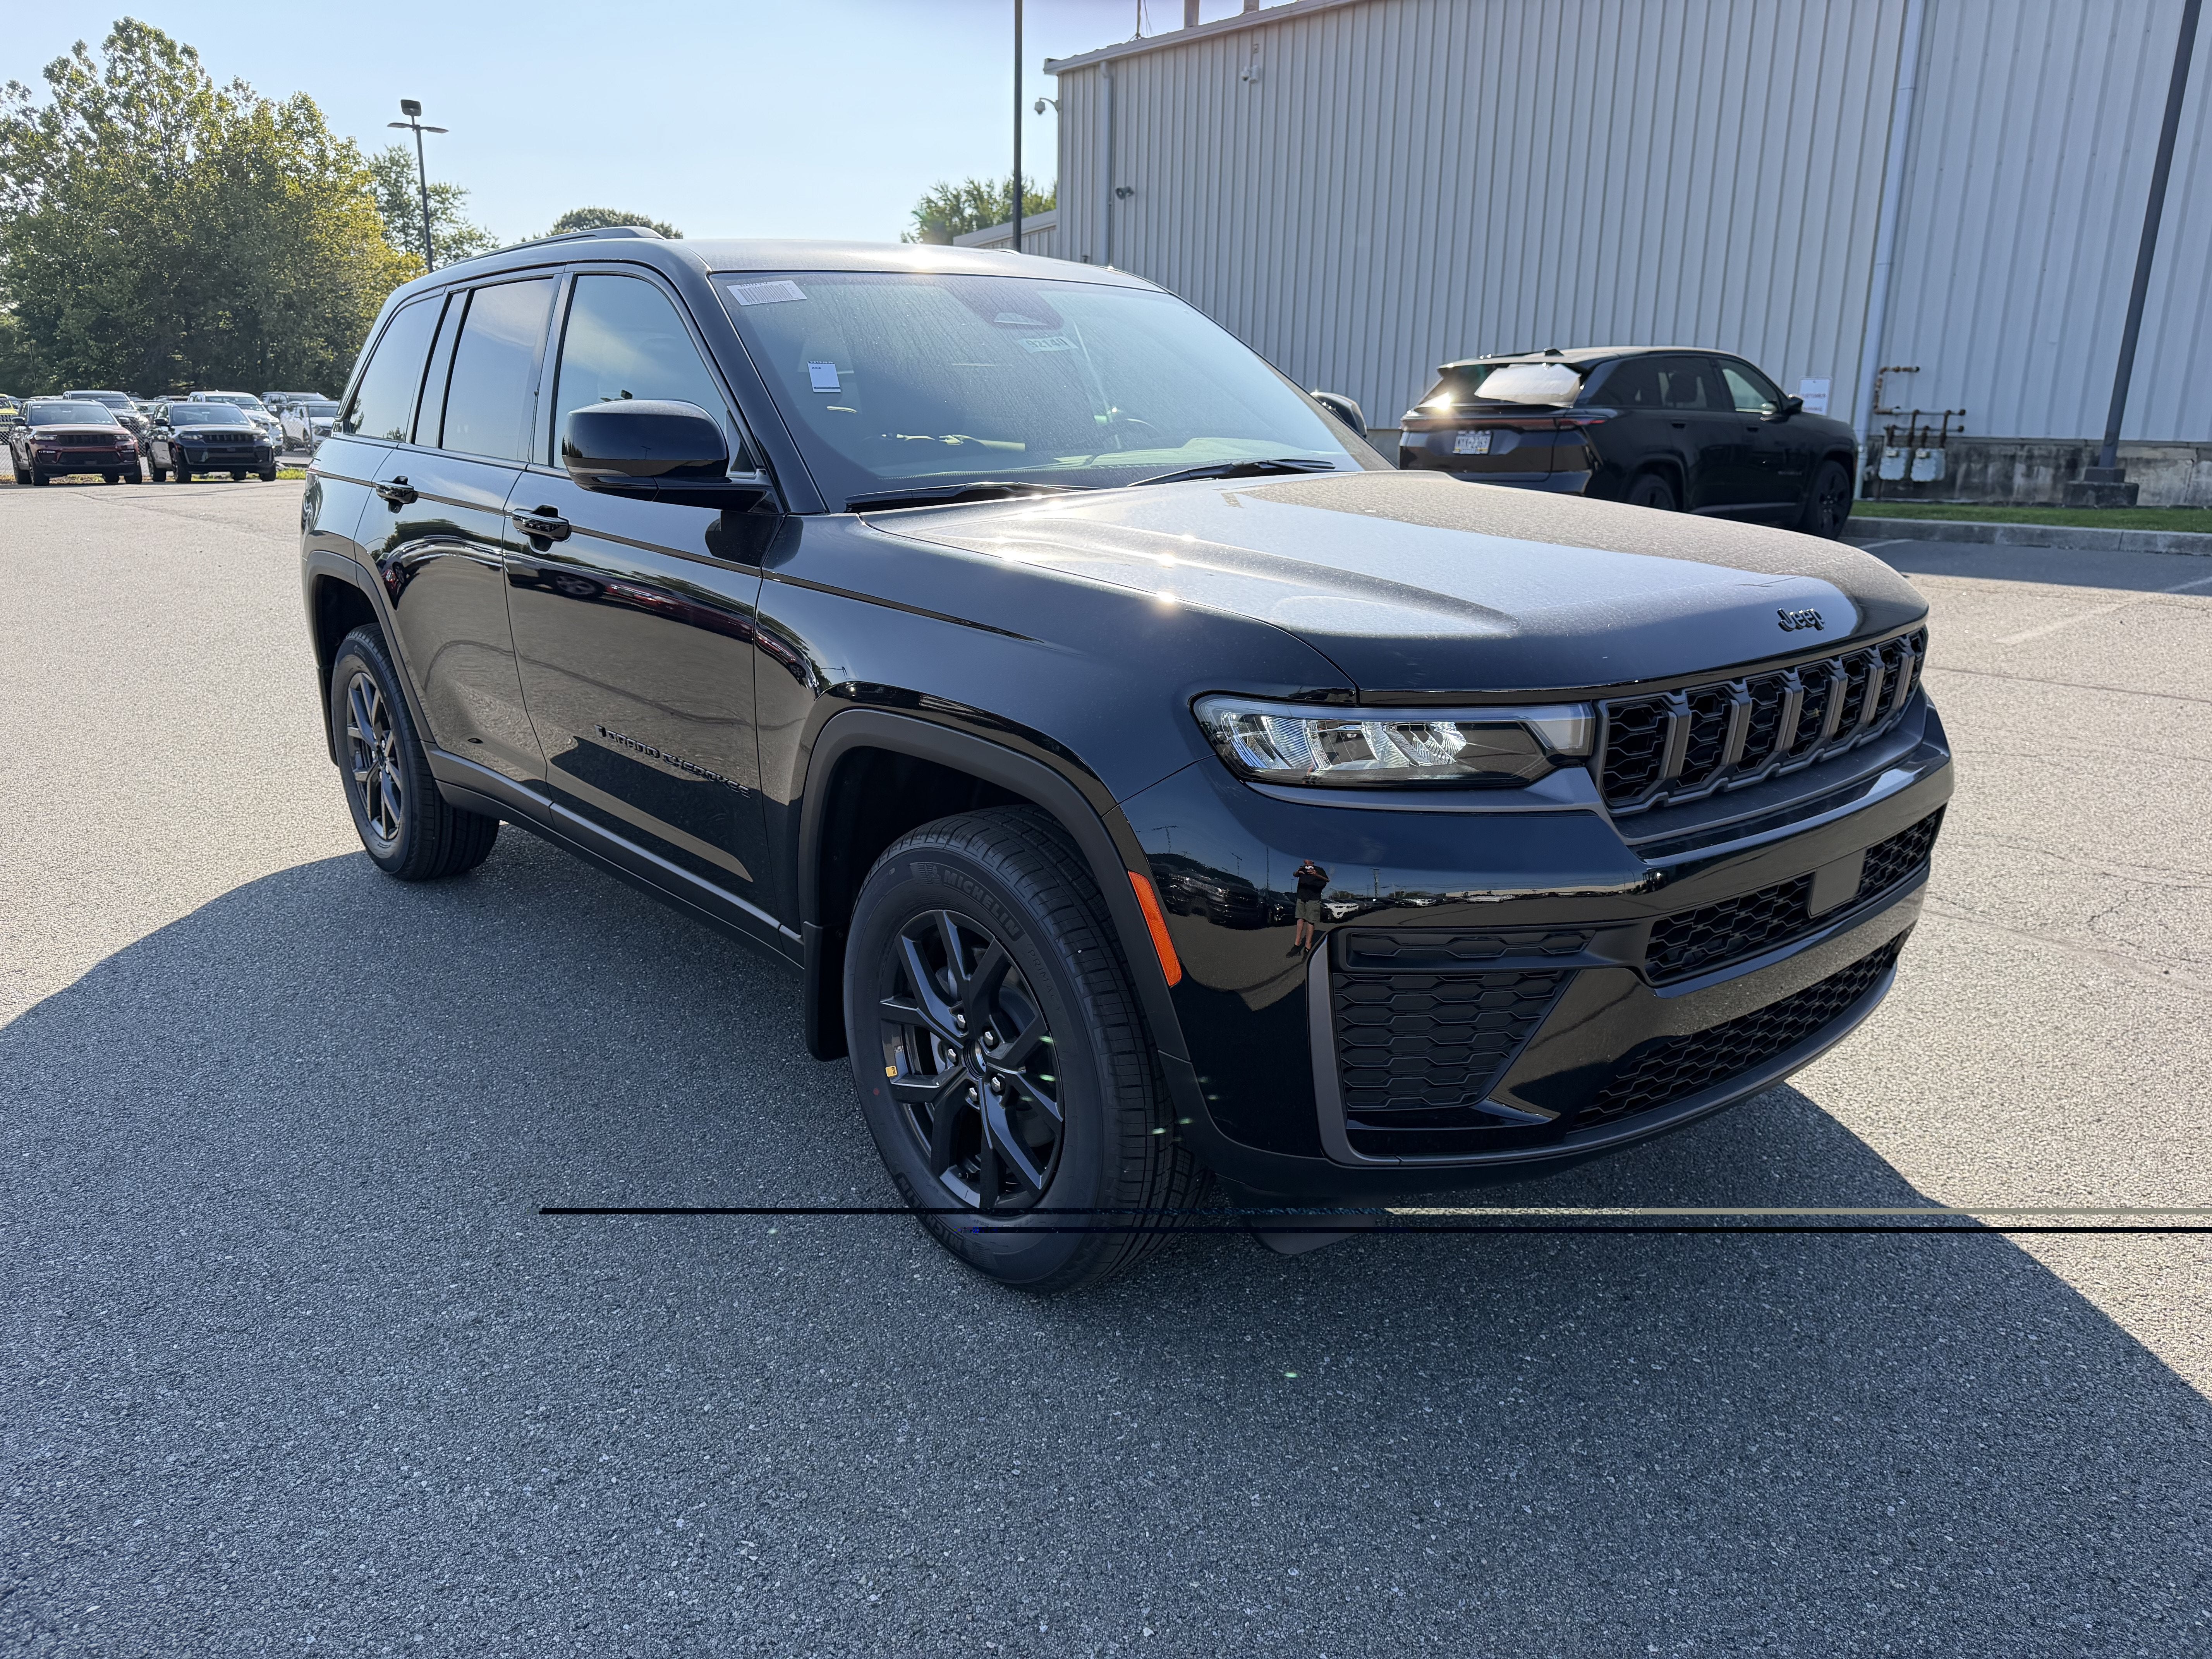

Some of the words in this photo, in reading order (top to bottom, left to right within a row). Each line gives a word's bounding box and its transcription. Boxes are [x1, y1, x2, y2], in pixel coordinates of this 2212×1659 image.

[1777, 608, 1825, 632] Jeep
[607, 730, 661, 759] GRAND
[662, 752, 752, 799] CHEROKEE
[943, 869, 1021, 937] MICHELIN
[1027, 950, 1063, 1017] PRIMACY
